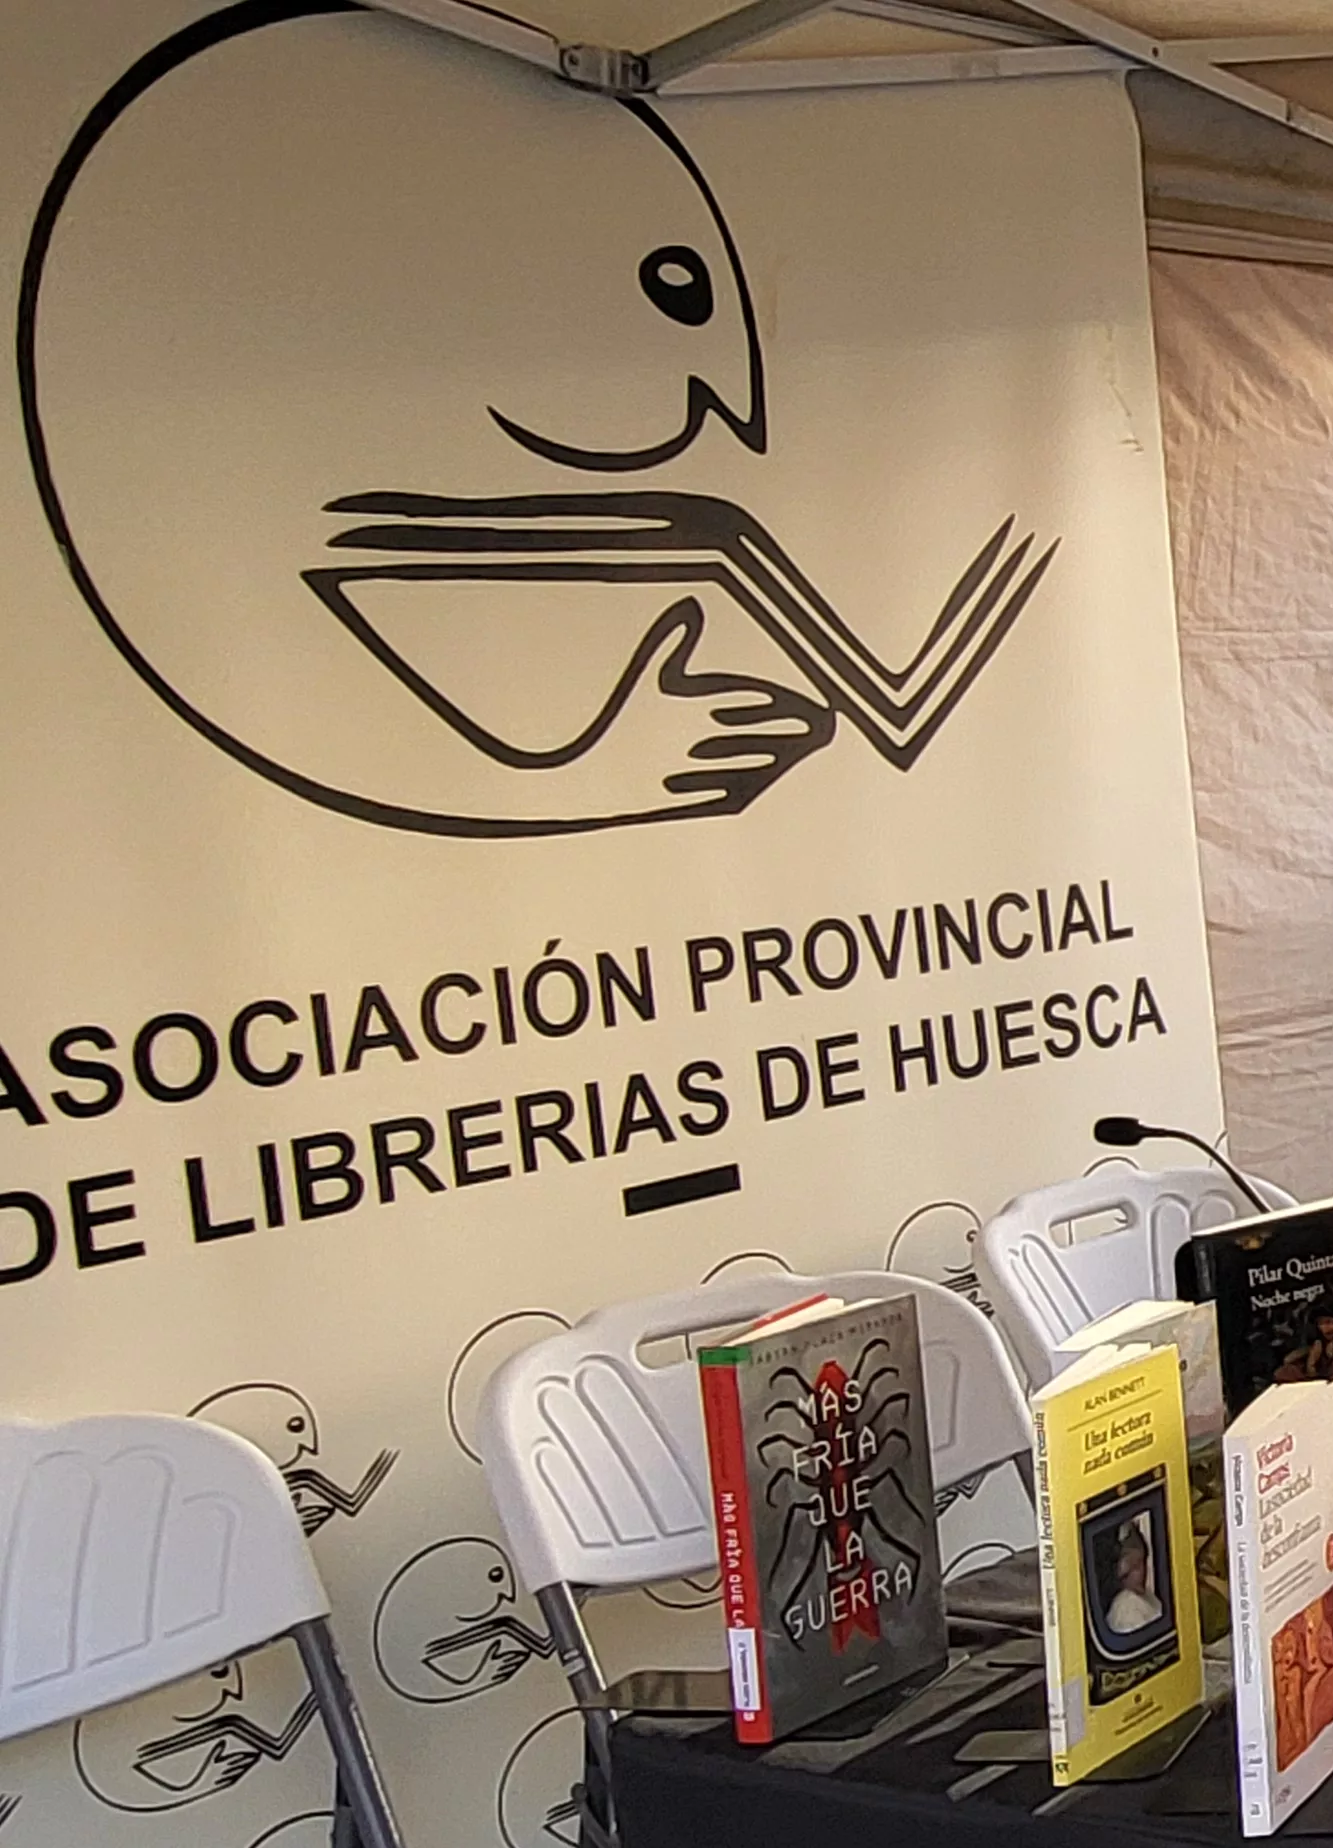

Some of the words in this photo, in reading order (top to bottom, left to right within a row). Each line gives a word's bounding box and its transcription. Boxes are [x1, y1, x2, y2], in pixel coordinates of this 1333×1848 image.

[0, 938, 656, 1127] ASOCIACIÓN
[686, 879, 1134, 1013] PROVINCIAL
[0, 1169, 146, 1286] DE
[184, 1060, 731, 1243] LIBRERIAS
[757, 1031, 866, 1121] DE
[889, 976, 1167, 1093] HUESCA
[1248, 1264, 1284, 1288] Pilar
[1250, 1289, 1291, 1312] Noche
[797, 1379, 863, 1425] MÁS
[792, 1421, 878, 1484] FRÍA
[807, 1474, 874, 1527] QUE
[823, 1529, 865, 1573] LA
[728, 1574, 745, 1606] QUE
[785, 1560, 913, 1640] GUERRA
